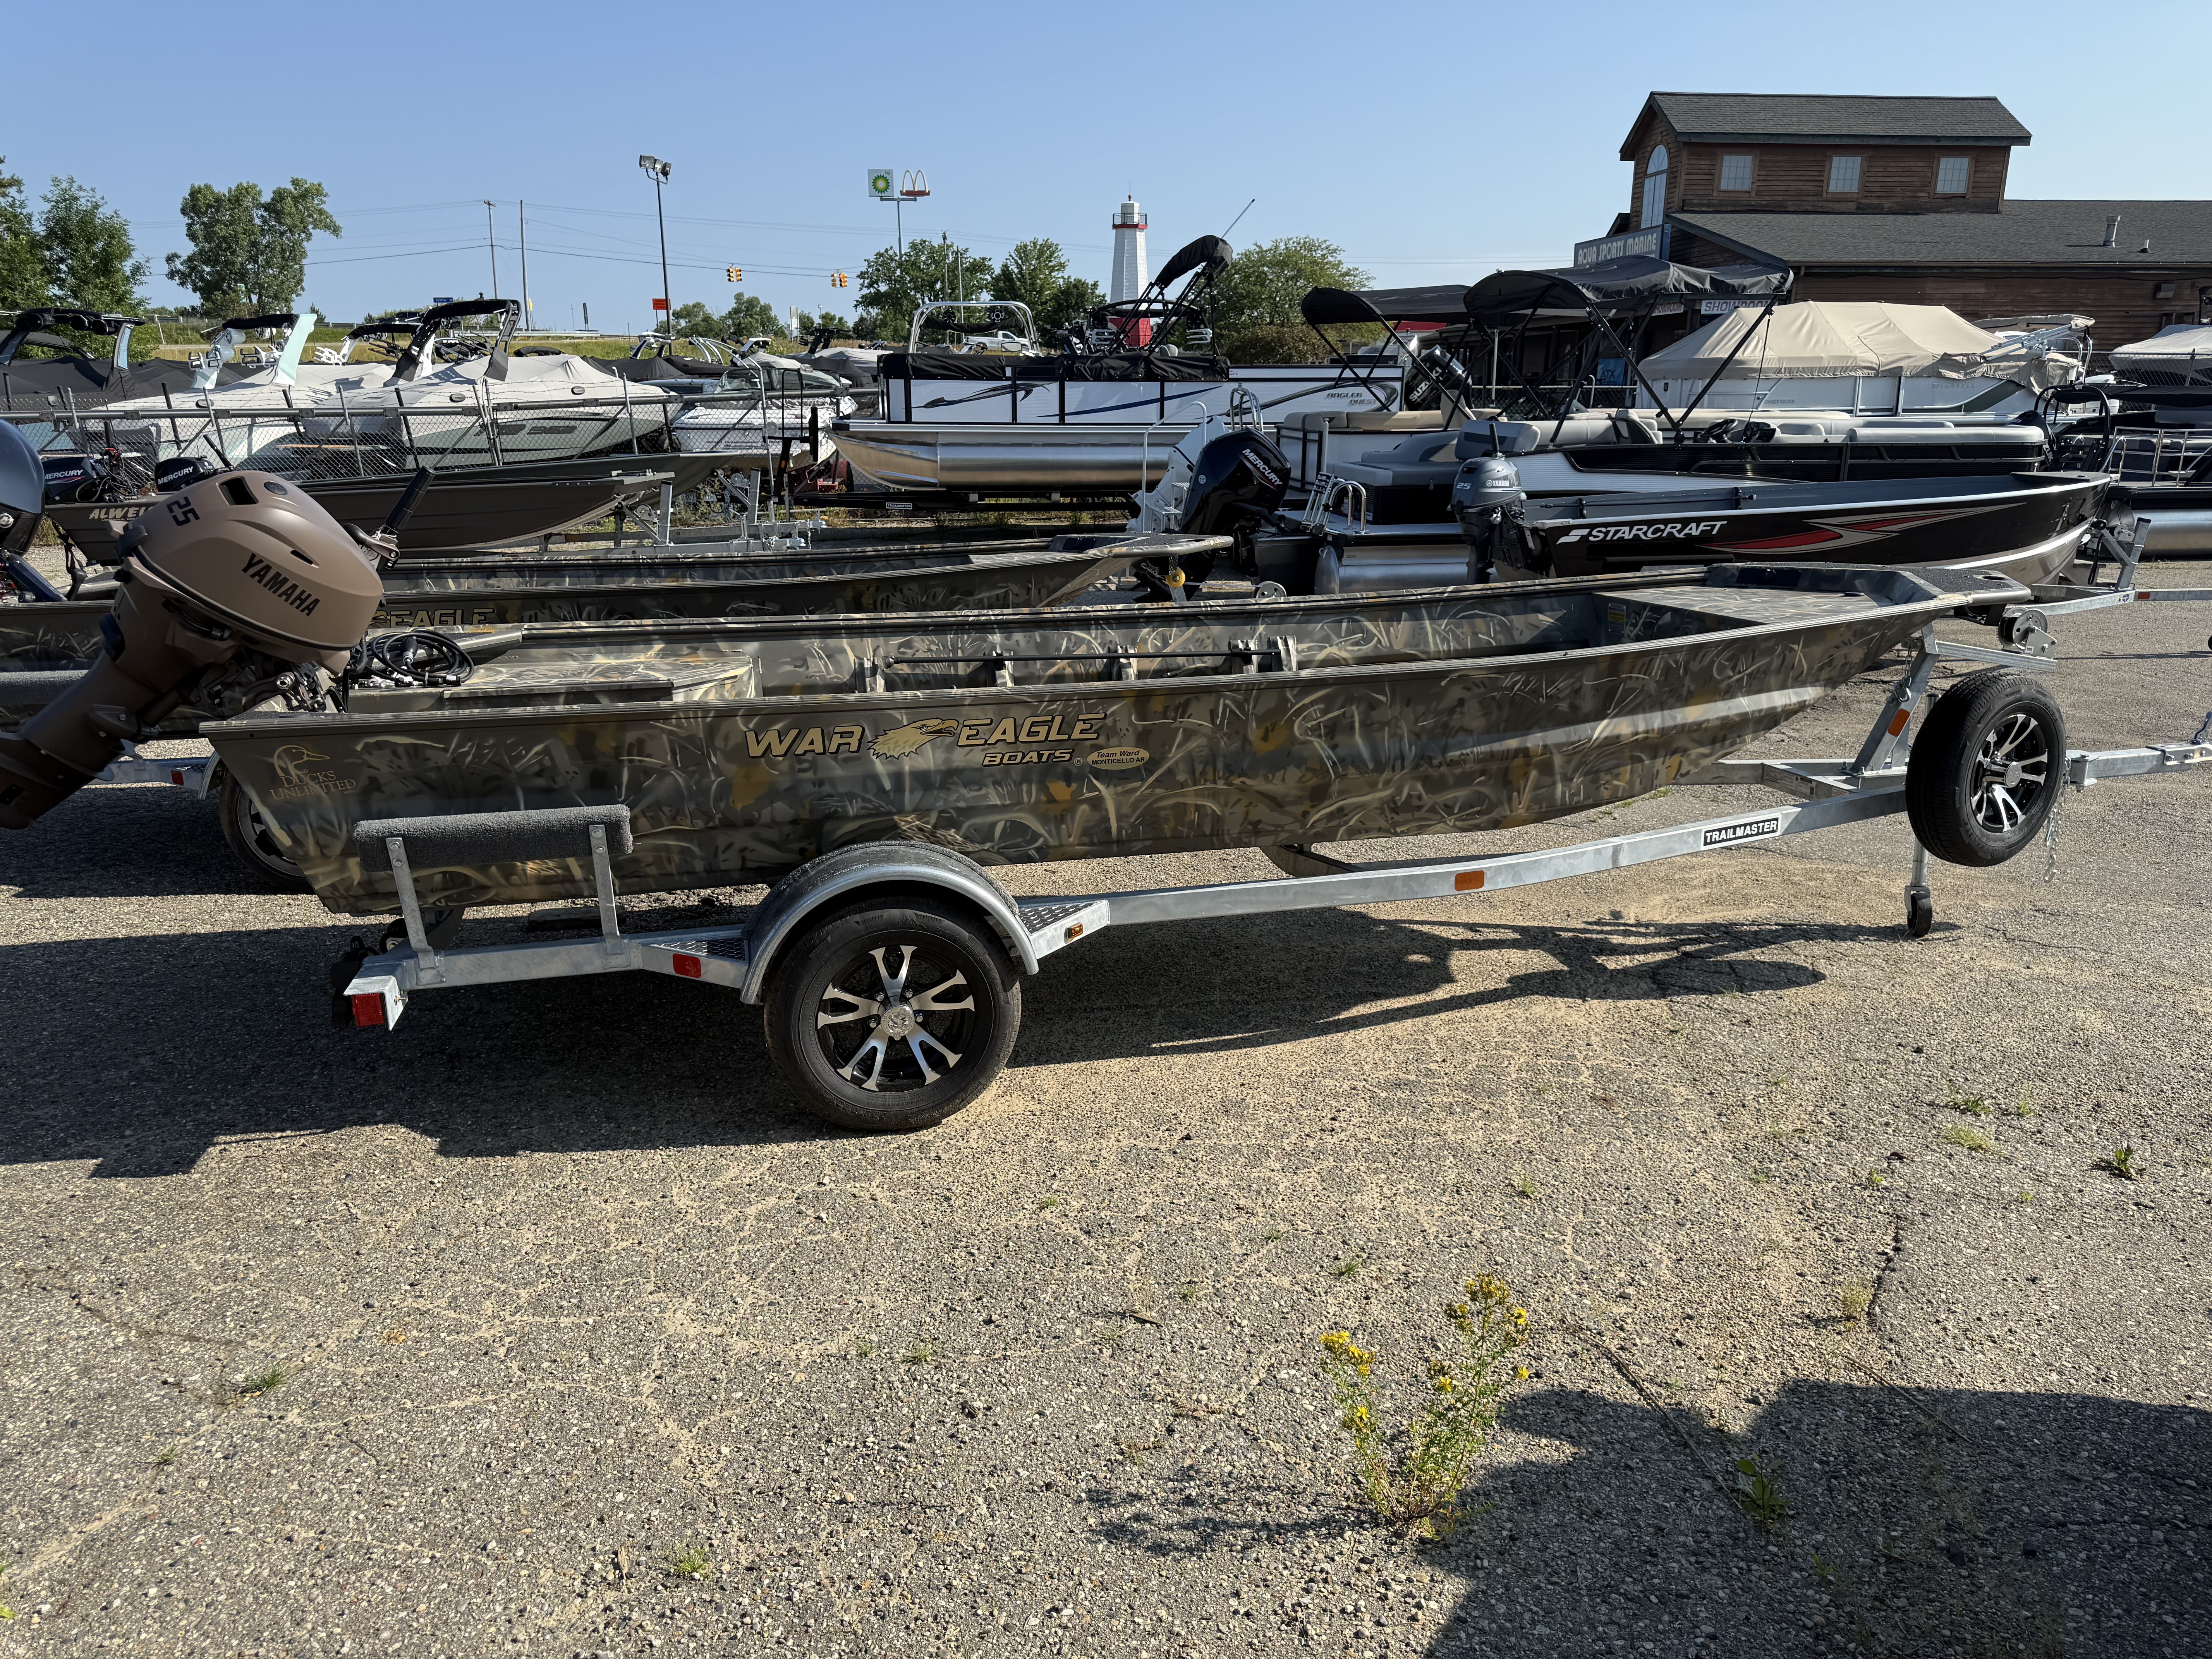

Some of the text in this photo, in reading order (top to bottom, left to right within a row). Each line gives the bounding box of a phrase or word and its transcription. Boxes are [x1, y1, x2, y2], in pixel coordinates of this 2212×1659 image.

[1599, 240, 1624, 261] SPORTS
[1626, 233, 1657, 256] MARINE
[1653, 302, 1682, 313] HOWROOM
[158, 466, 193, 485] MERCURY
[1242, 448, 1283, 485] MERCURY
[166, 496, 200, 527] 25
[1589, 520, 1728, 541] STARCRAFT
[241, 552, 321, 617] YAMAHA
[389, 608, 495, 628] EAGLE
[745, 713, 1107, 759] WAR EAGLE
[982, 749, 1075, 767] BOATS
[1092, 757, 1134, 765] MONTICELLO
[269, 779, 356, 800] UNLIMITED
[280, 771, 336, 788] DUCKS
[1705, 820, 1778, 843] TRAILMASTER
